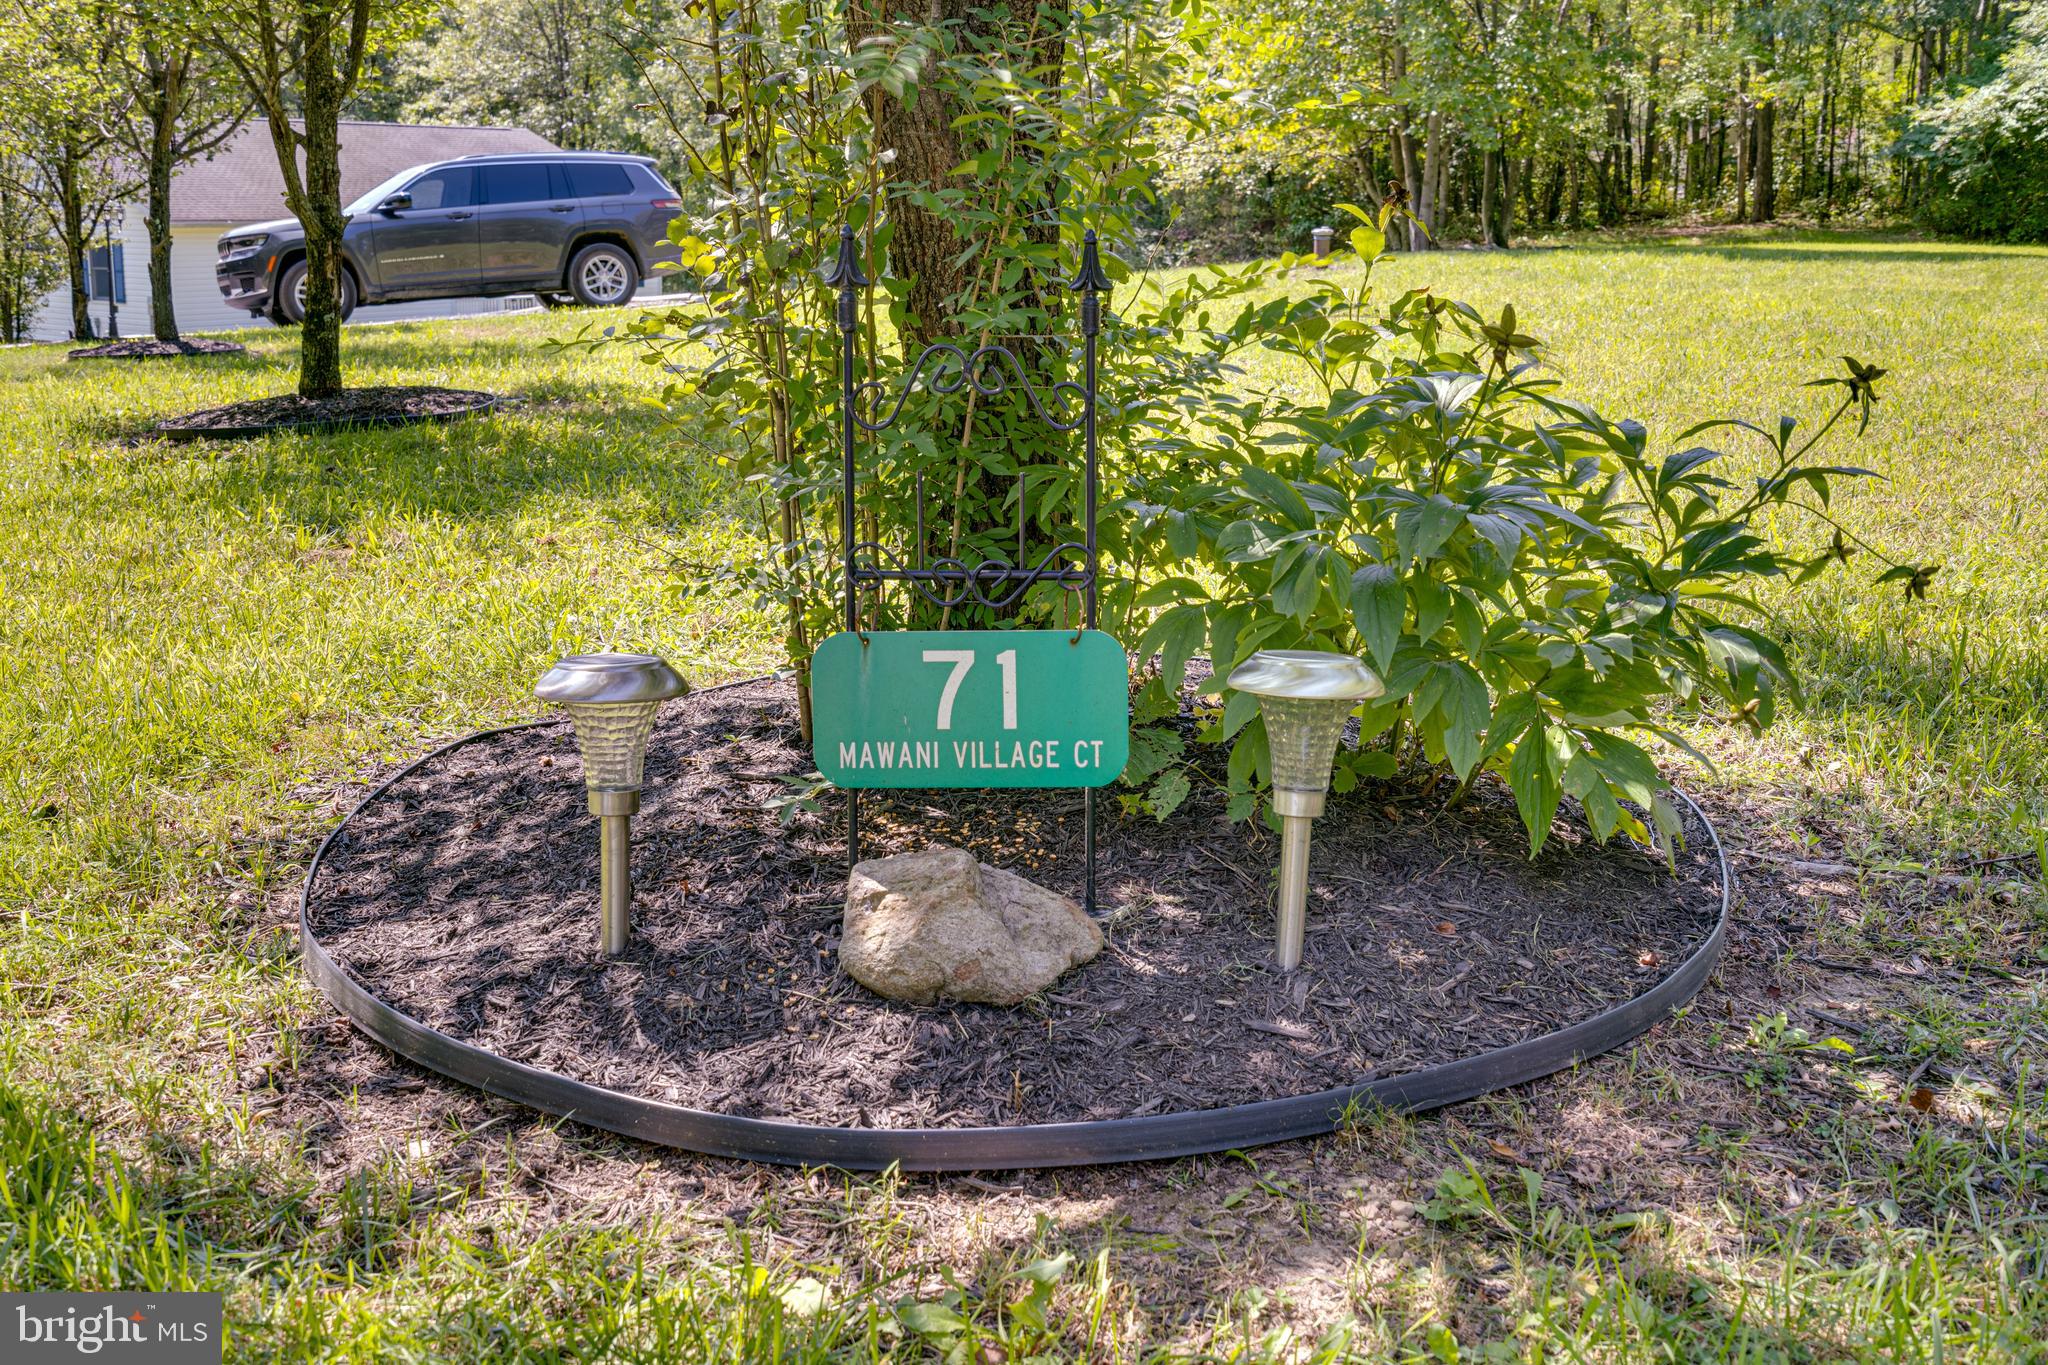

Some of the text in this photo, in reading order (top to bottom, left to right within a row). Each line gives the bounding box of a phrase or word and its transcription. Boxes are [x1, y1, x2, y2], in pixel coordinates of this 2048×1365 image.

[922, 649, 1018, 730] 71
[839, 739, 1104, 769] MAWANI VILLAGE CT
